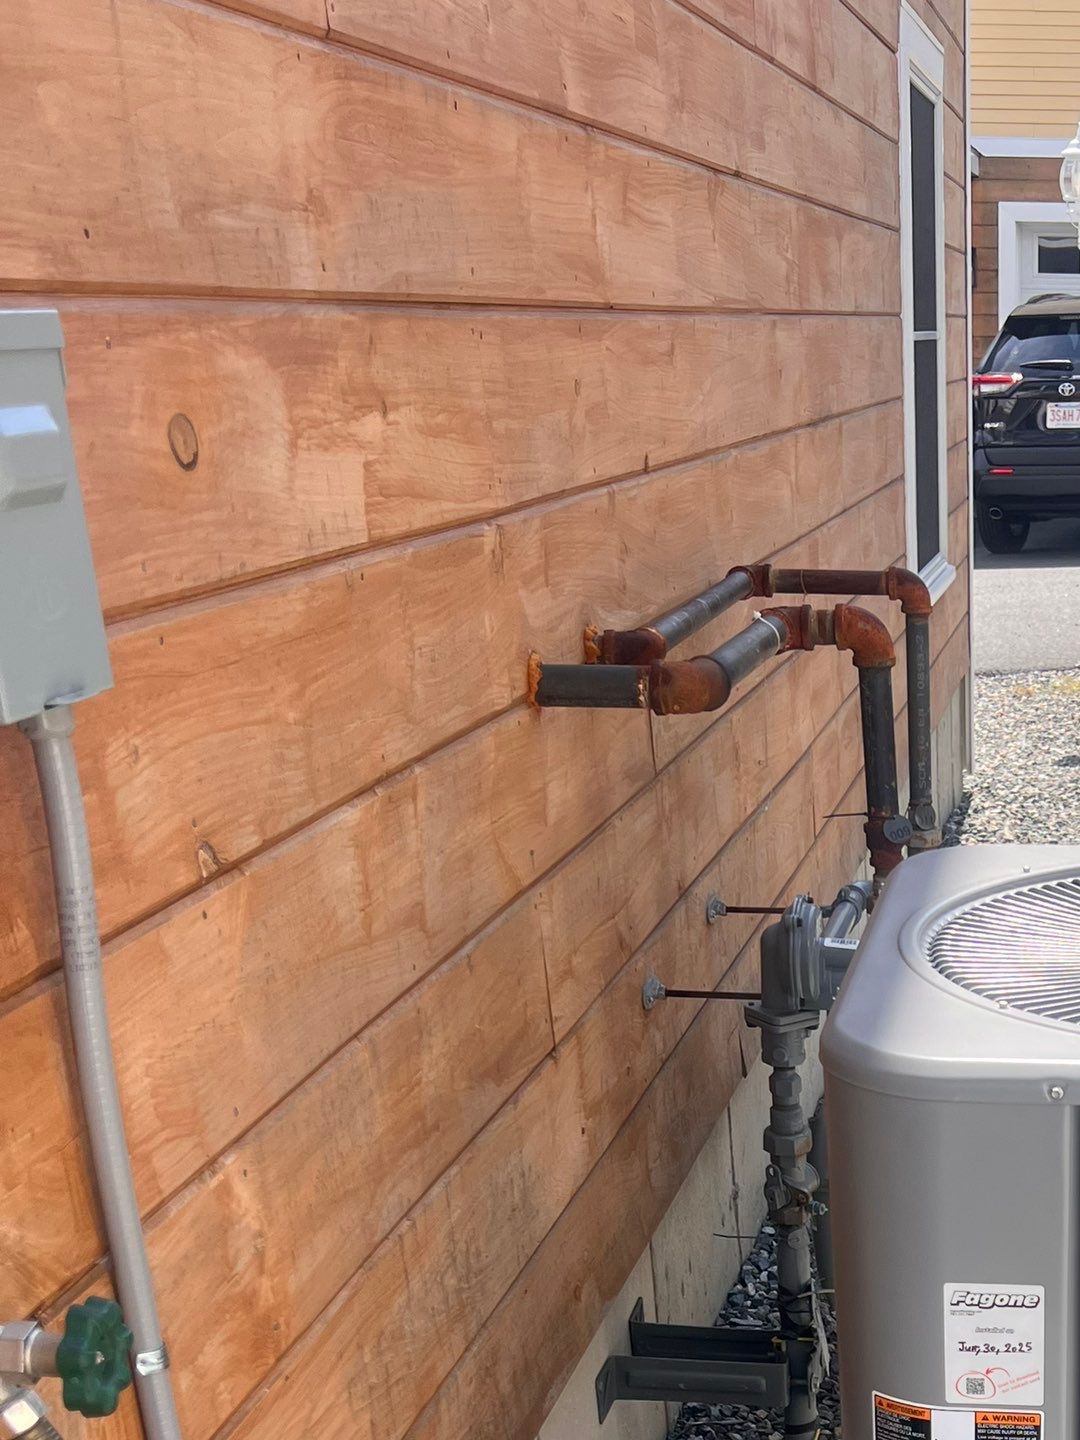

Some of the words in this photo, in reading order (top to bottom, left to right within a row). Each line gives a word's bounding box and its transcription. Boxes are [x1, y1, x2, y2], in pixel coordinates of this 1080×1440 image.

[1050, 409, 1074, 421] 3SAH
[950, 1291, 1040, 1309] Fagone
[1004, 1342, 1033, 1354] 2025
[886, 1401, 926, 1417] AVERTISSEMENT
[992, 1415, 1036, 1423] WARNING
